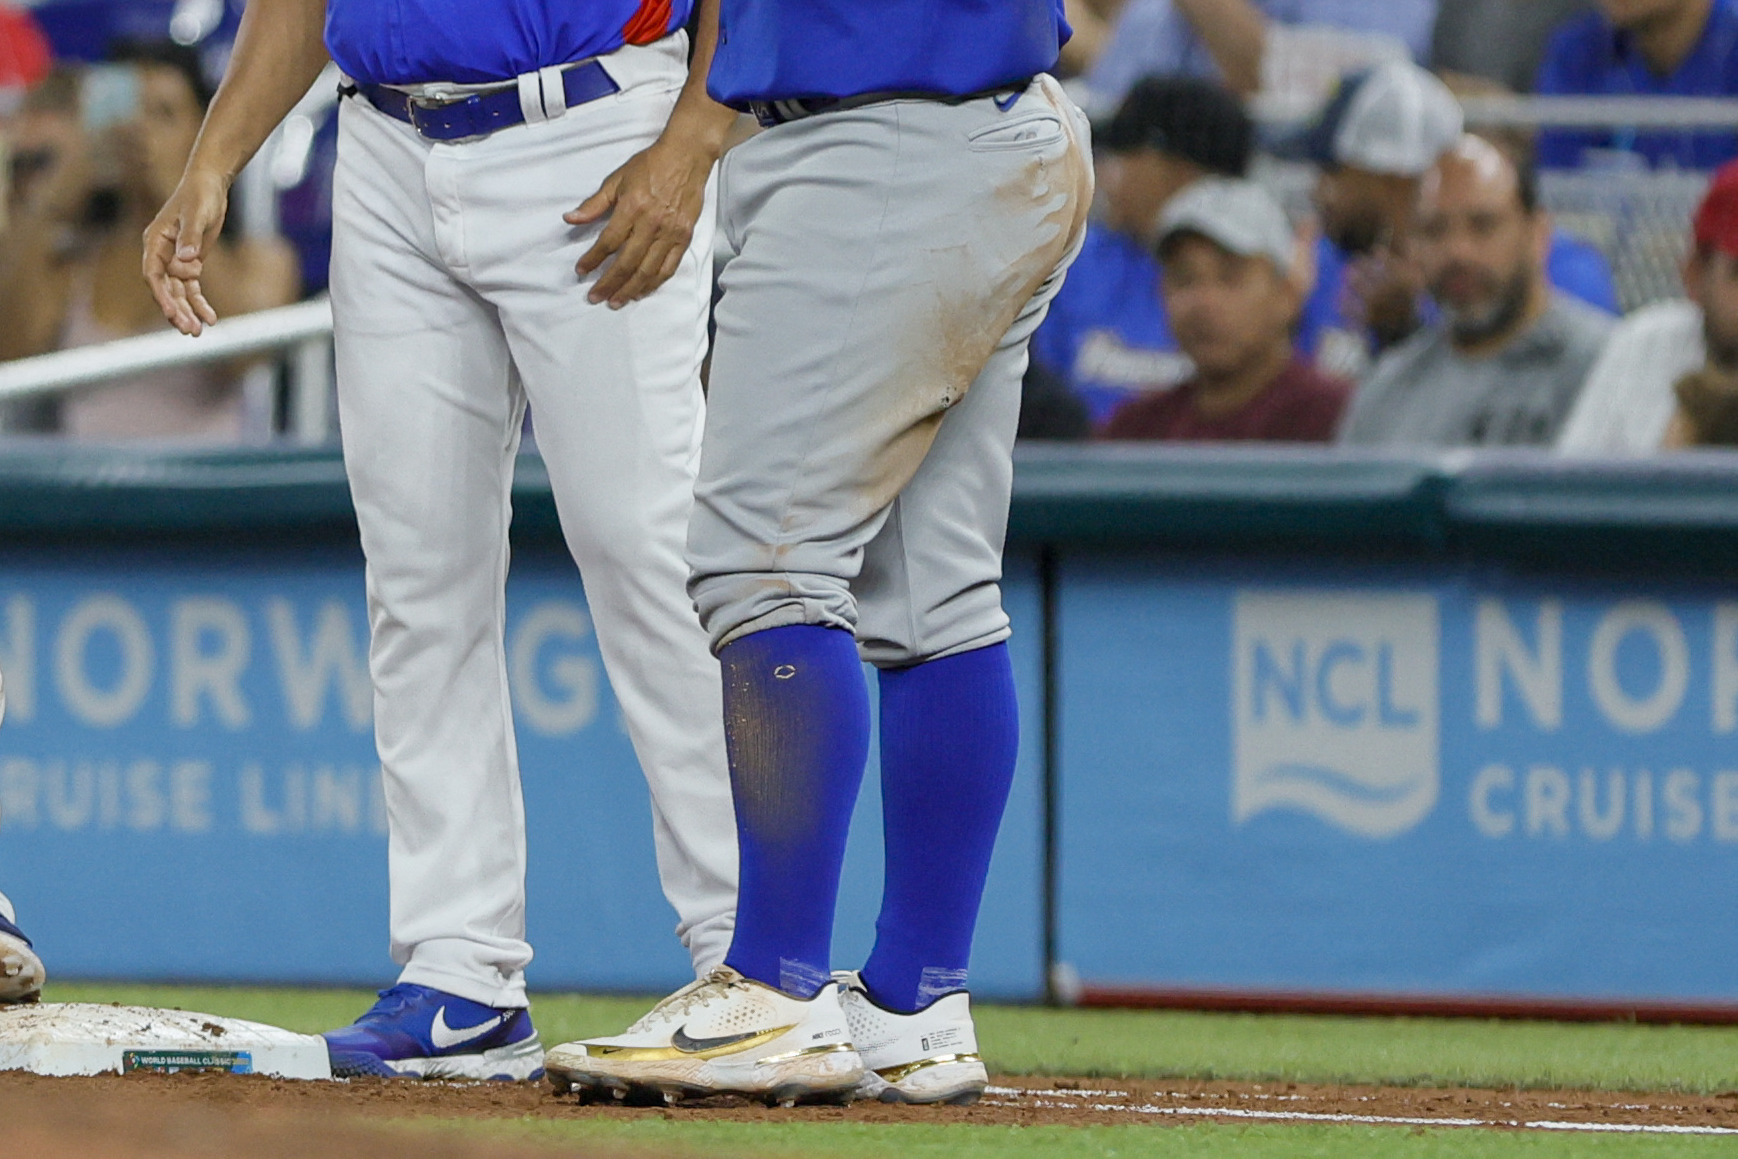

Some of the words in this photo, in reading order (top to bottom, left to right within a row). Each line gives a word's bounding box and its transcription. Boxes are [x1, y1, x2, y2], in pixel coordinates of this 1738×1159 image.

[1252, 638, 1421, 726] NCL
[141, 1055, 166, 1065] WORLD
[166, 1055, 202, 1066] BASEBALL
